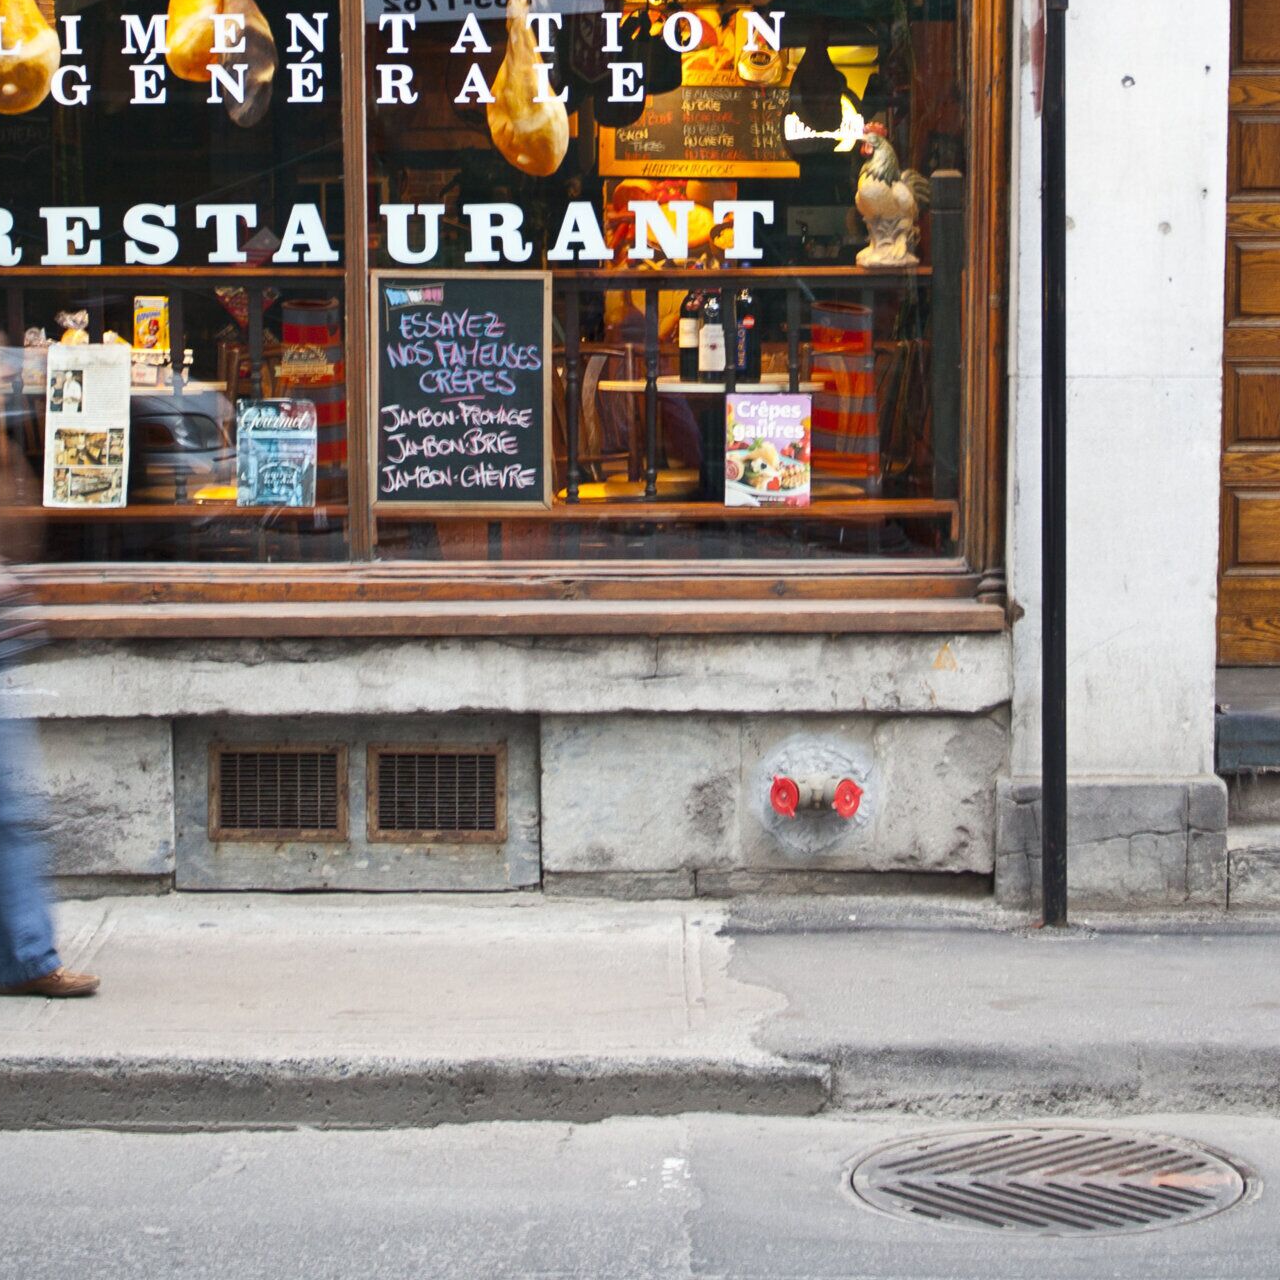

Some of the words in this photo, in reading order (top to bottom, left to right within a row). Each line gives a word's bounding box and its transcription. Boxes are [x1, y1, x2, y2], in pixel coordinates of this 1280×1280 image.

[400, 308, 506, 339] ESSAYEZ
[386, 340, 433, 368] NOS
[239, 407, 310, 433] Gourmet
[736, 399, 802, 421] Crêpes
